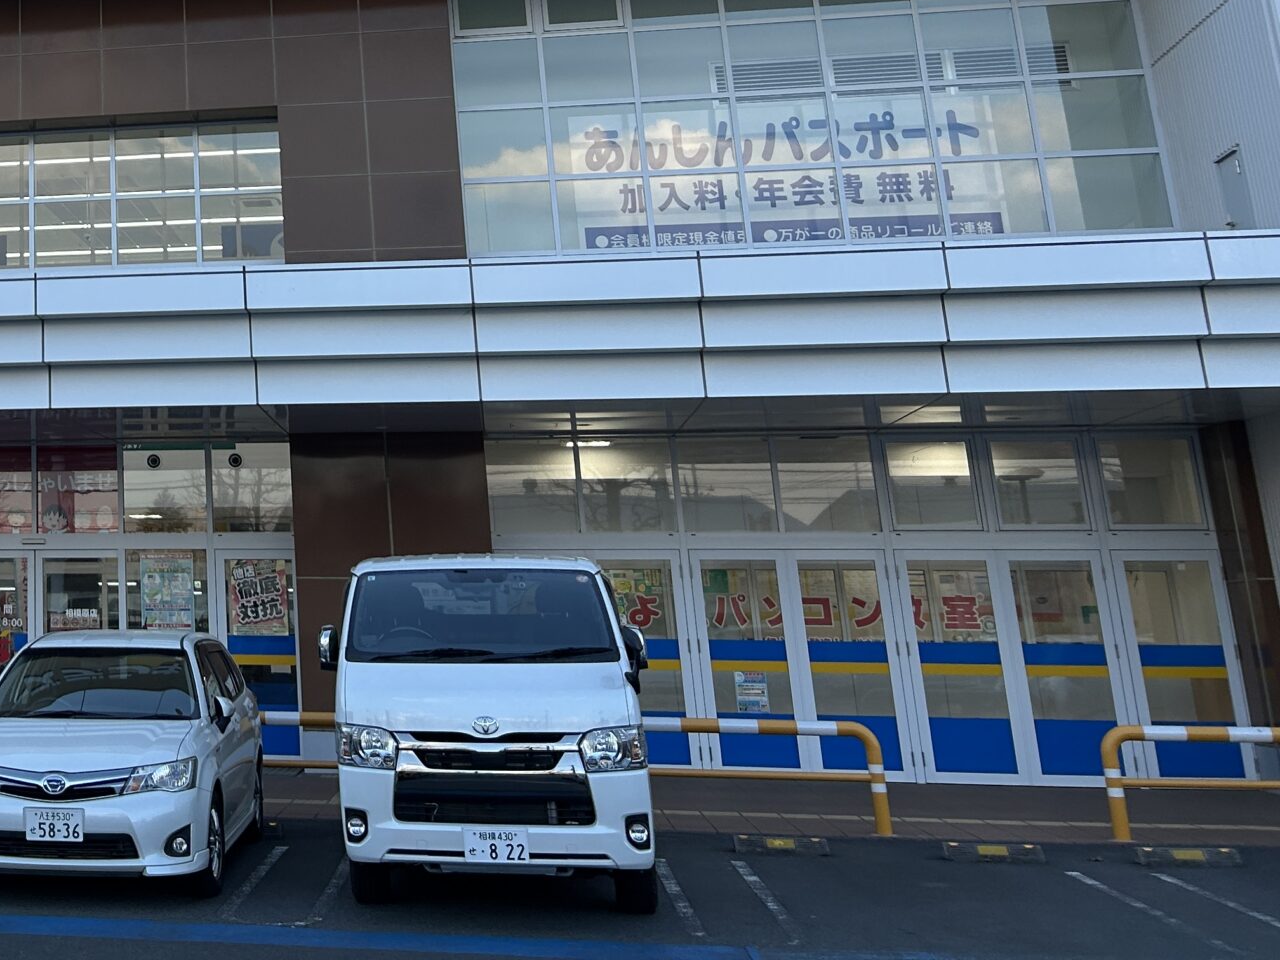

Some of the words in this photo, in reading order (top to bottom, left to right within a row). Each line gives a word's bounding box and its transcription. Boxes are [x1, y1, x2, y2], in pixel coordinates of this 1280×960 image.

[583, 109, 981, 174] あんしんパスポート
[236, 575, 281, 600] 徹底
[237, 597, 283, 622] 対抗
[38, 822, 80, 839] 58-36
